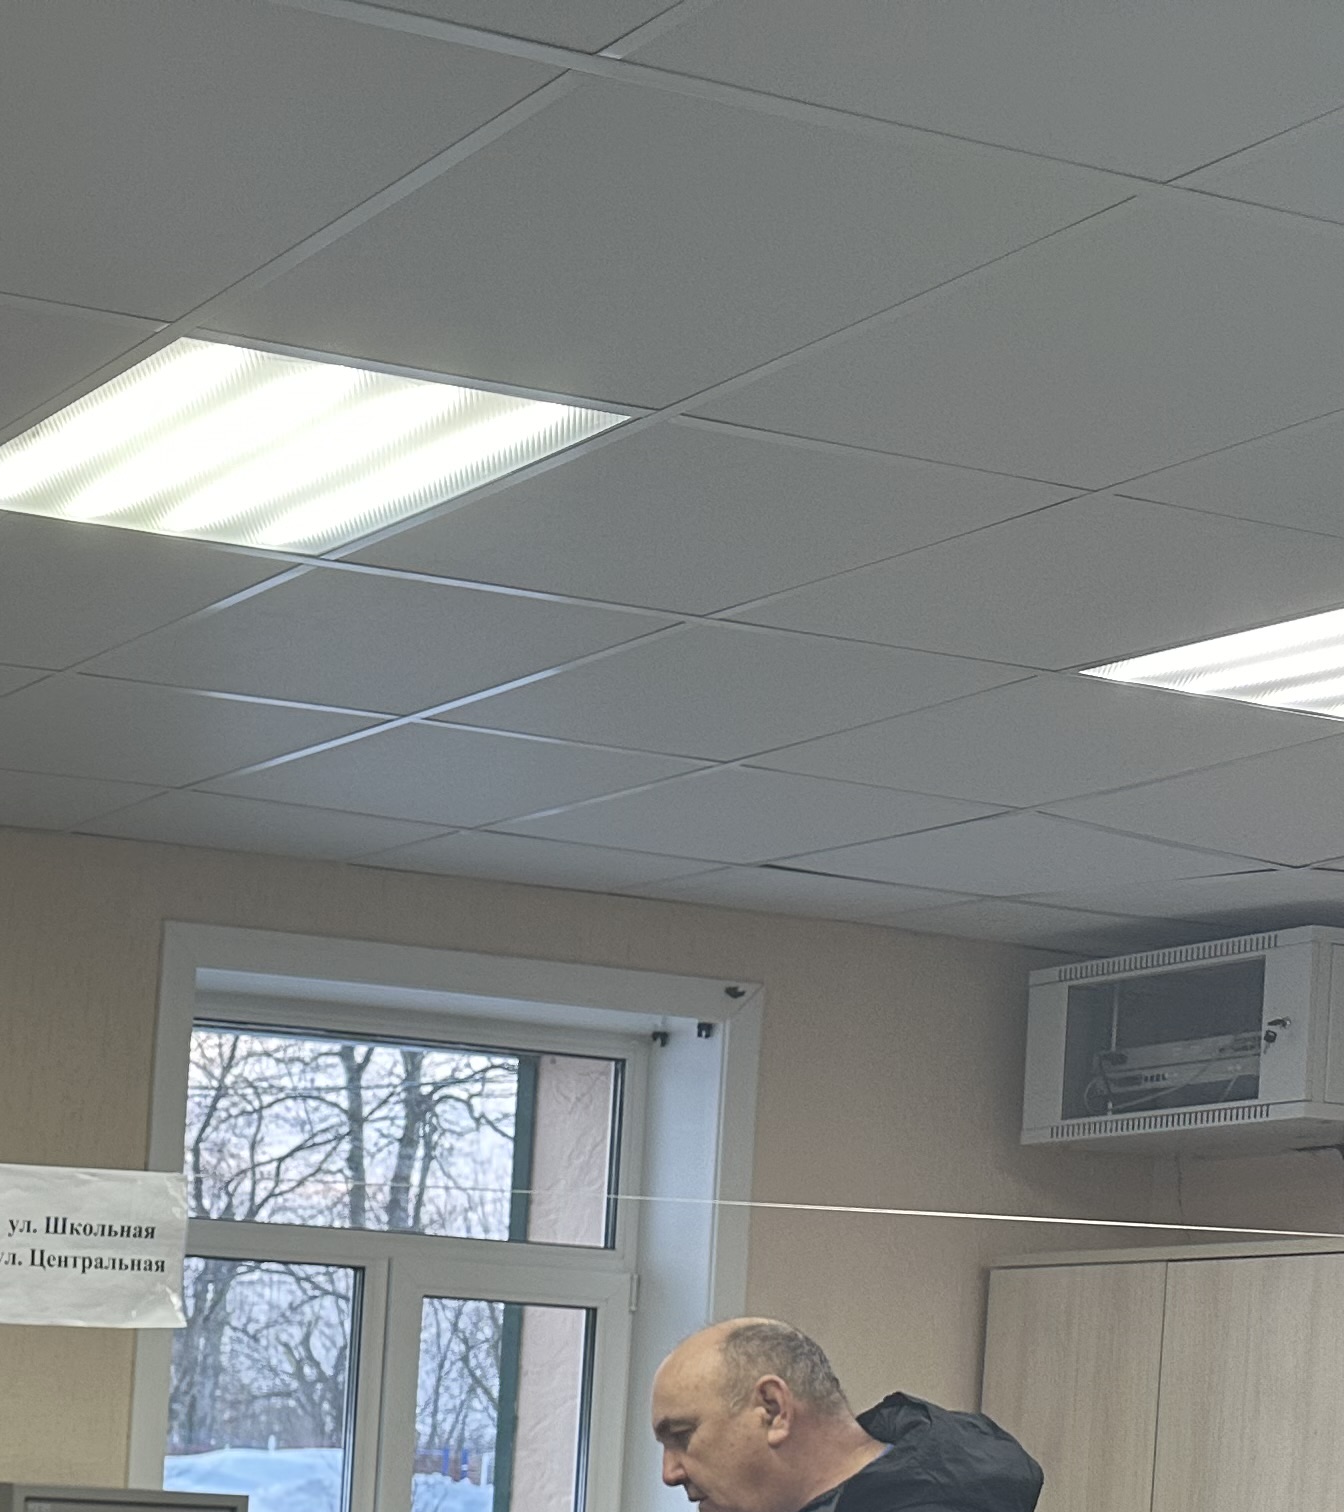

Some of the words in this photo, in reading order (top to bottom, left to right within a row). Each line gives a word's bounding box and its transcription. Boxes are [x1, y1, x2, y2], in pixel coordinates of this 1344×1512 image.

[7, 1218, 38, 1238] ул.
[44, 1216, 157, 1240] Школьная
[29, 1249, 166, 1274] Центральная
